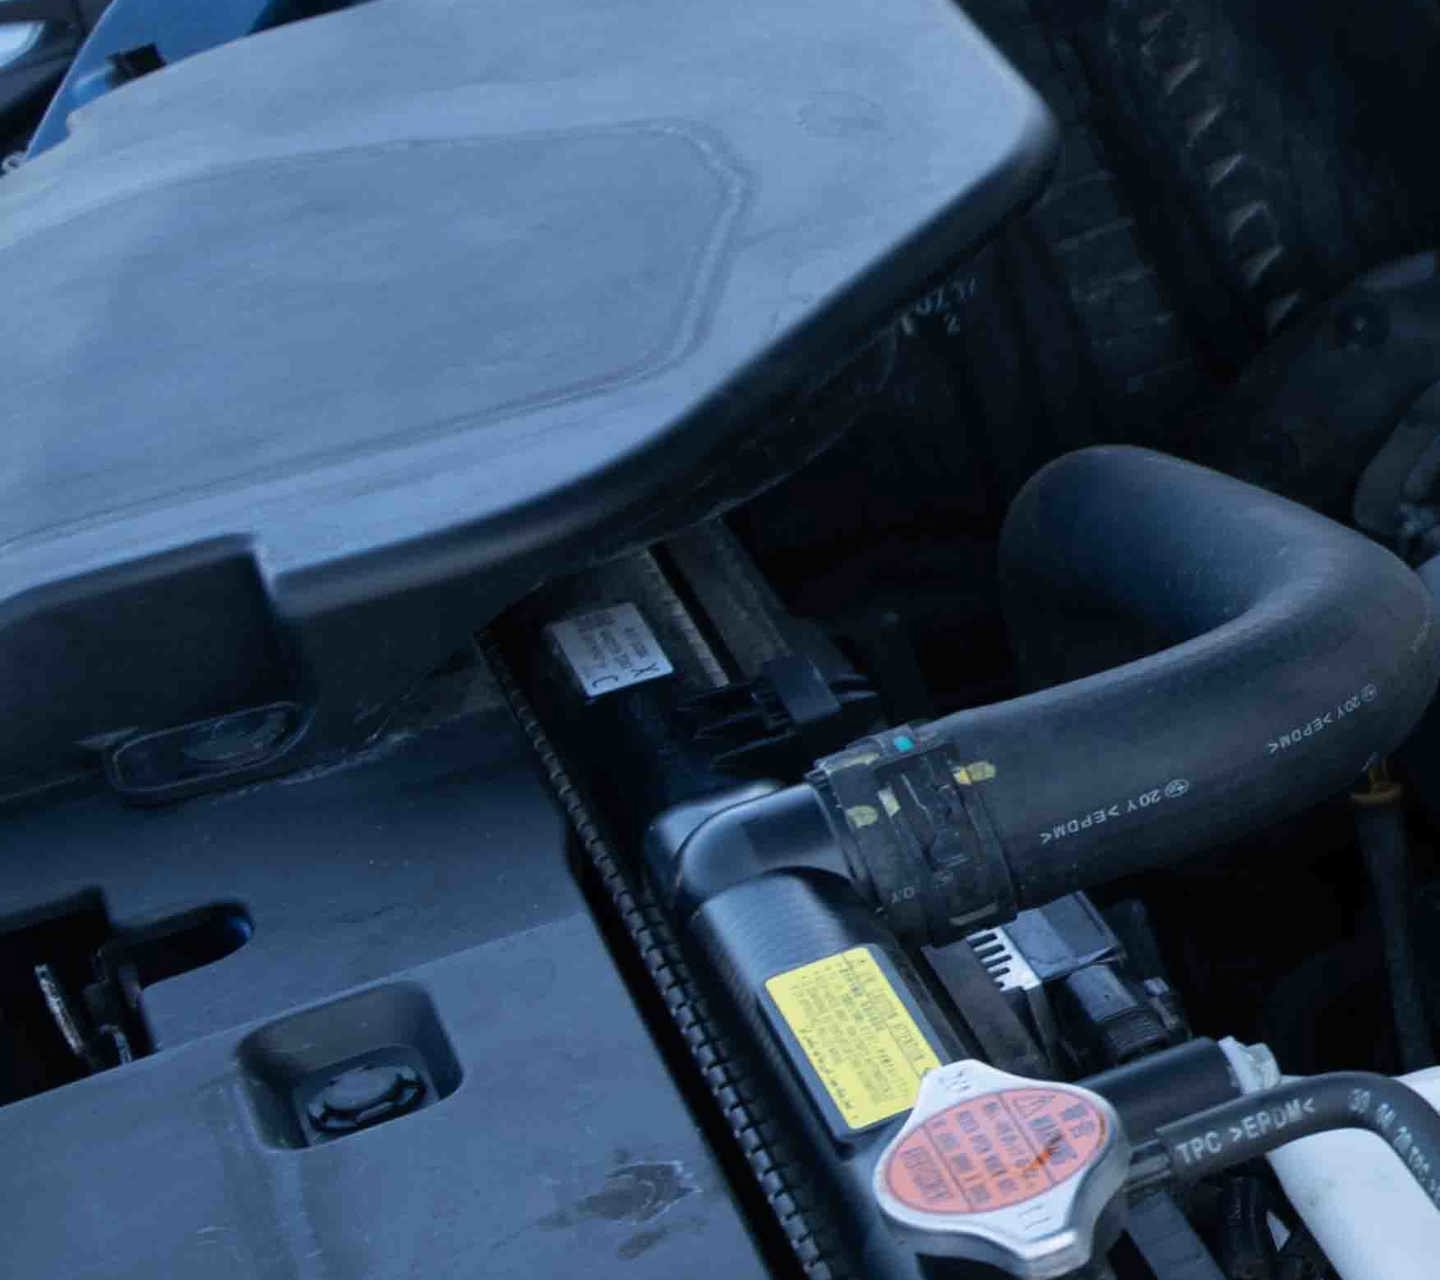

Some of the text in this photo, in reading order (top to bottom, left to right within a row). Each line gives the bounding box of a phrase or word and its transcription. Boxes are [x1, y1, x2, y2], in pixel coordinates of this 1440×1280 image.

[1039, 789, 1161, 845] 20Y >EPDM<
[1175, 1096, 1317, 1164] TPC >EPDM<
